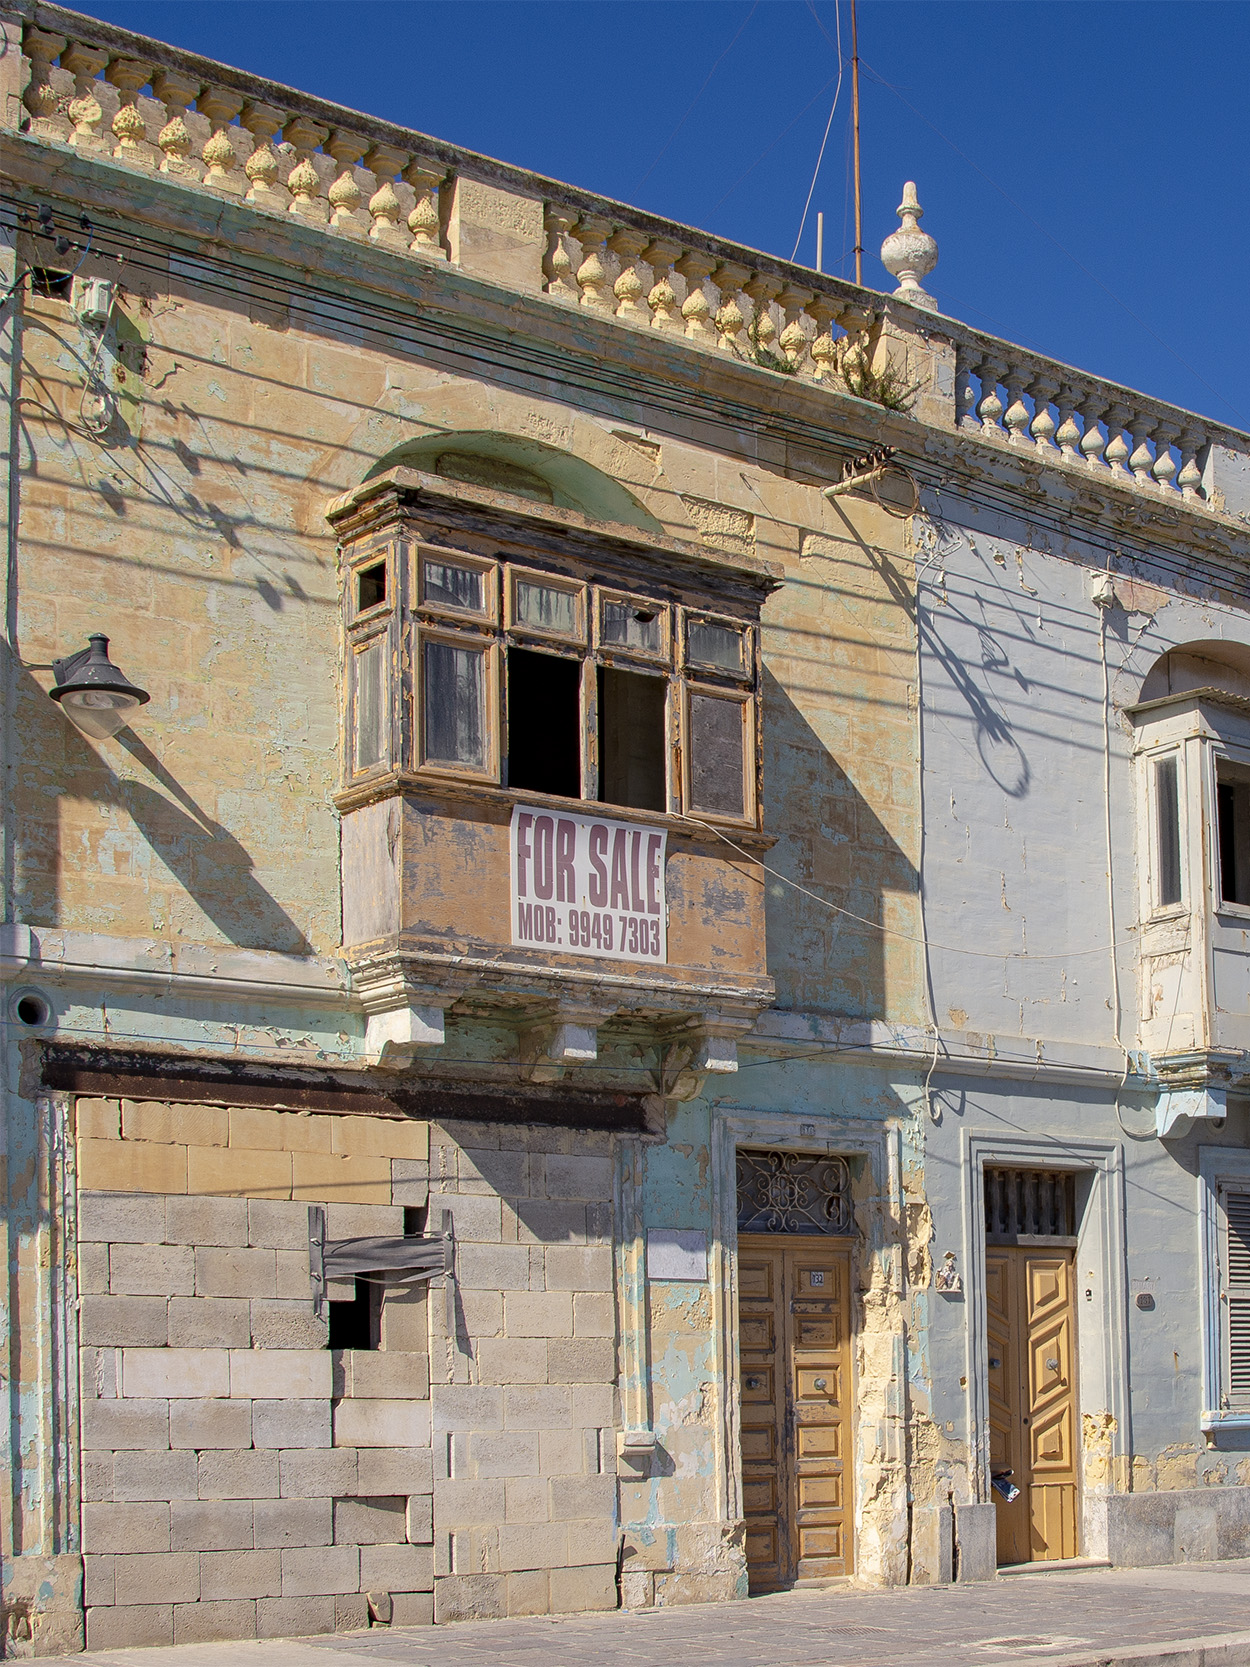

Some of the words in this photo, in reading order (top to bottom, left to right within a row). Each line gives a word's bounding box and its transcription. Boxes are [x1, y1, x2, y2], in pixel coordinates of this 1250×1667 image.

[517, 812, 576, 904] FOR
[588, 824, 662, 915] SALE
[518, 902, 562, 945] MOB:
[568, 909, 614, 951] 9949
[618, 915, 661, 957] 7303
